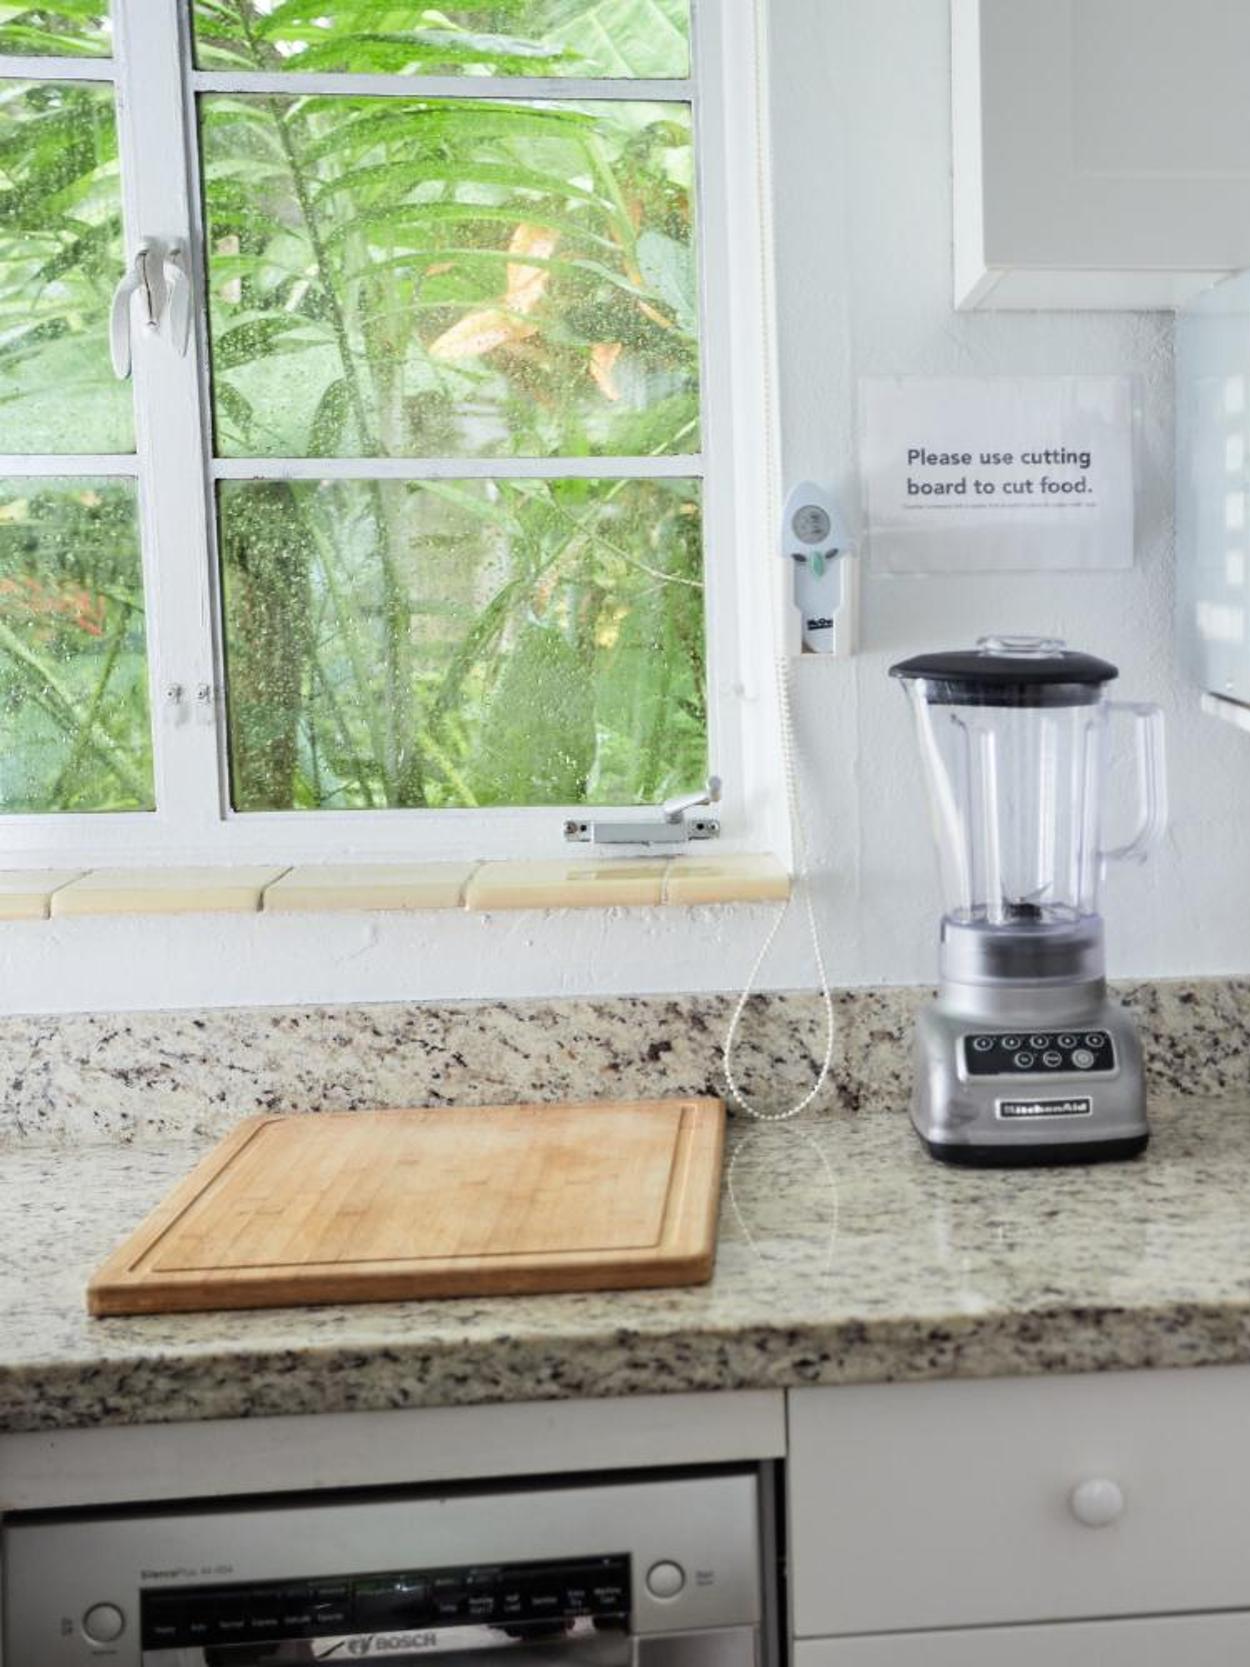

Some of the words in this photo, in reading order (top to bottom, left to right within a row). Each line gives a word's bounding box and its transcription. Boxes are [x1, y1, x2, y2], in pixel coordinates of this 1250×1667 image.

[907, 448, 972, 465] Please
[979, 452, 1013, 465] use
[1020, 447, 1091, 469] cutting
[907, 477, 967, 495] board
[974, 478, 995, 494] to
[1002, 478, 1034, 494] cut
[1040, 476, 1093, 494] food.
[1003, 1102, 1087, 1114] KitchenAid
[375, 1633, 438, 1650] BOSCH
